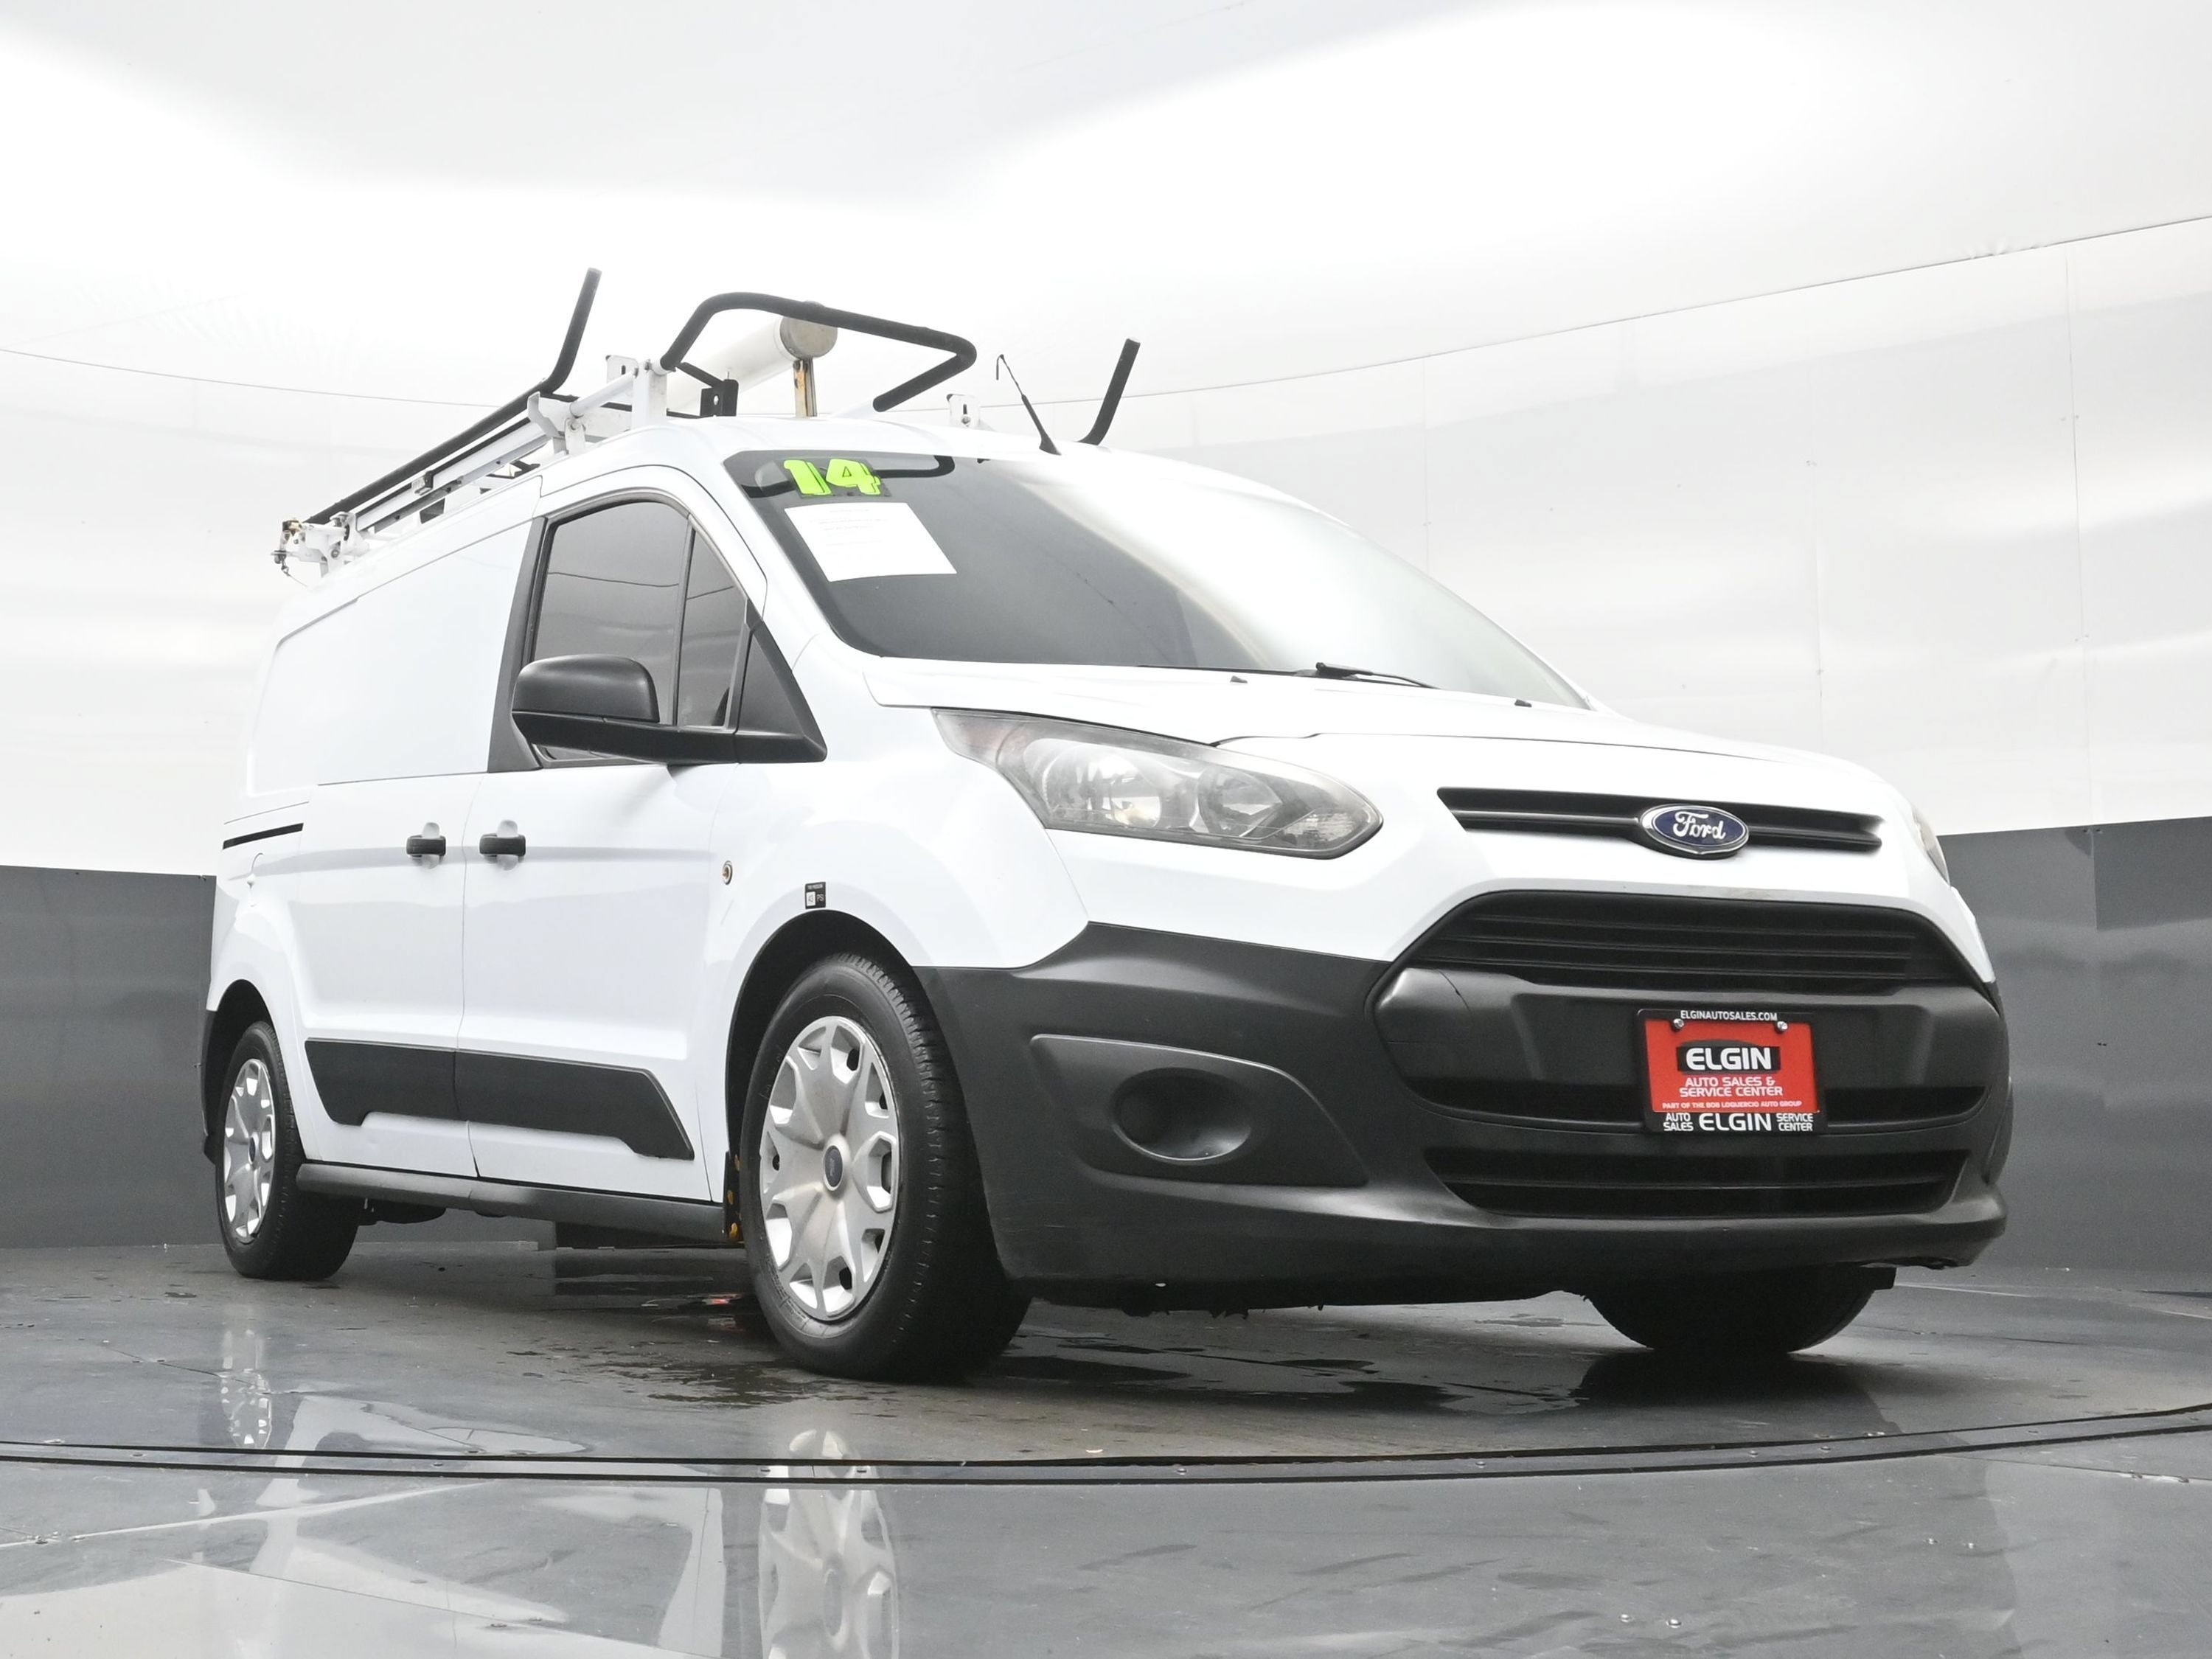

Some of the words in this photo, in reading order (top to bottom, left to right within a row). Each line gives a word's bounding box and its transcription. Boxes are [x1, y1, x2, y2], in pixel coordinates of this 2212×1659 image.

[783, 459, 881, 495] 14
[1672, 811, 1726, 840] Ford
[1680, 1009, 1778, 1021] ELGINAUTOSALES.COM
[1686, 1047, 1772, 1071] ELGIN
[1685, 1077, 1719, 1088] AUTO
[1722, 1077, 1762, 1087] SALES
[1765, 1077, 1775, 1086] &
[1679, 1087, 1733, 1098] SERVICE
[1735, 1086, 1784, 1097] CENTER
[1666, 1112, 1691, 1121] AUTO
[1699, 1113, 1772, 1131] ELGIN
[1775, 1113, 1814, 1122] SERVICE
[1663, 1121, 1694, 1131] SALES
[1778, 1122, 1813, 1132] CENTER
